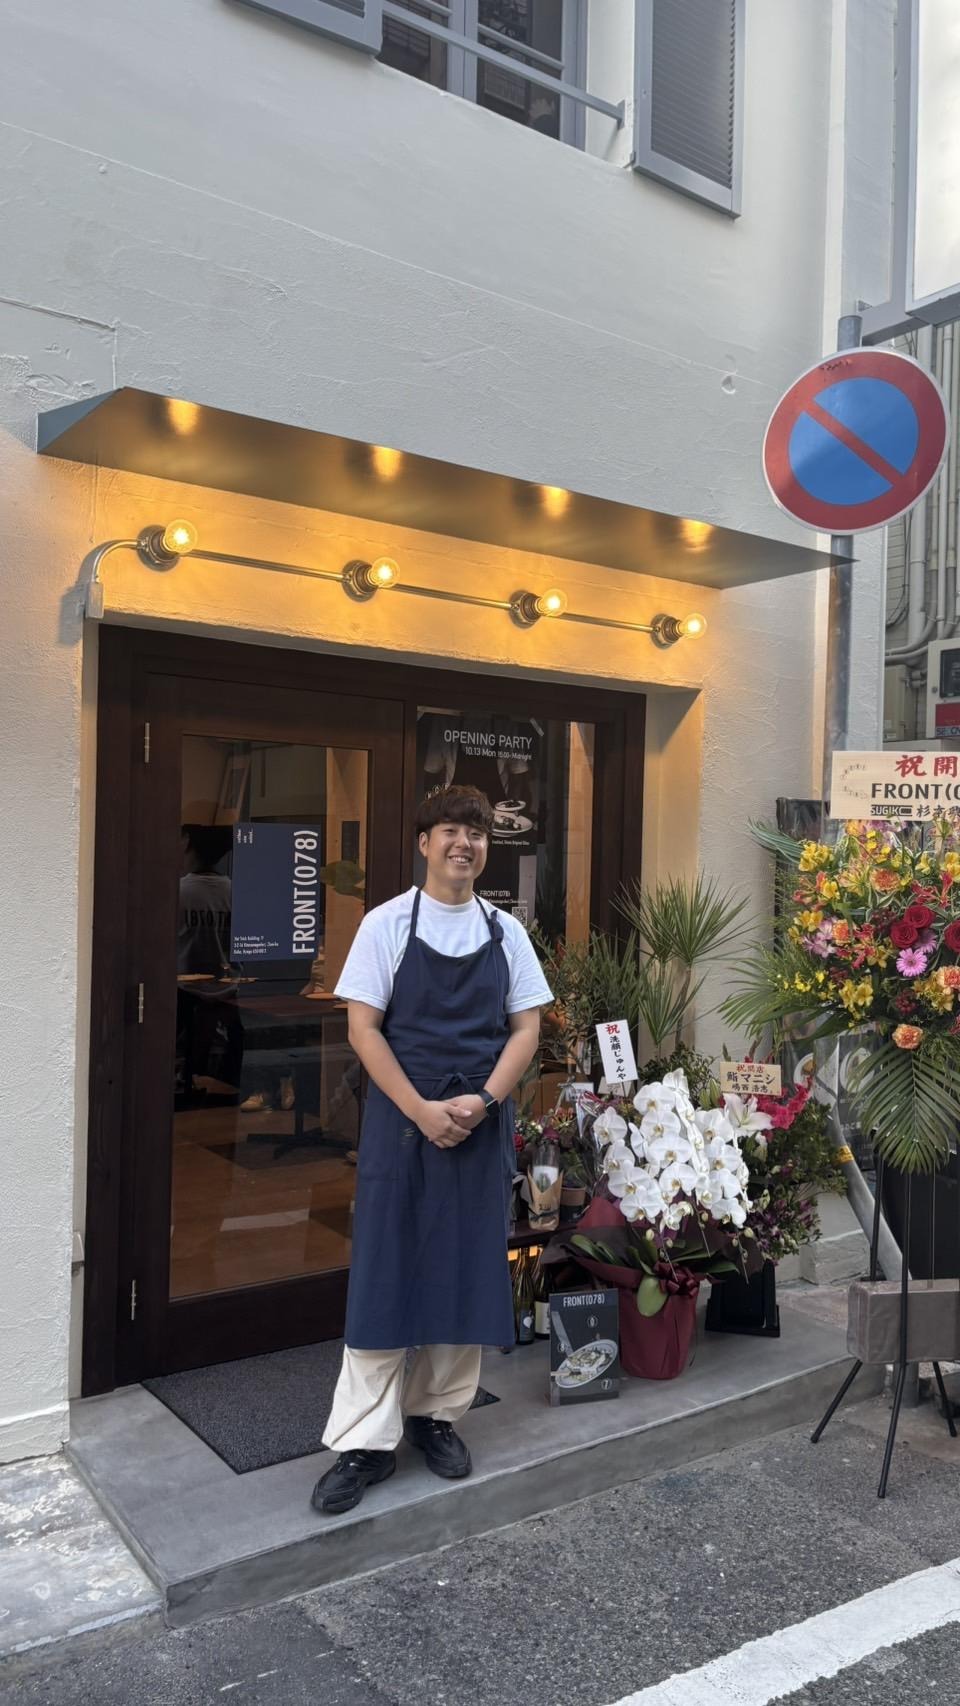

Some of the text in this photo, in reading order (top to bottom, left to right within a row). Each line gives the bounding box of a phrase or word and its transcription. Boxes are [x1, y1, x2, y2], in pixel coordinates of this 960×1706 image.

[444, 729, 533, 749] OPENING PARTY
[465, 747, 481, 756] 10.13
[482, 748, 497, 757] Mon
[292, 830, 319, 954] FRONT(078)
[605, 1024, 620, 1035] 祝
[736, 1064, 765, 1073] 祝開店
[563, 1293, 605, 1307] FRONT(078)
